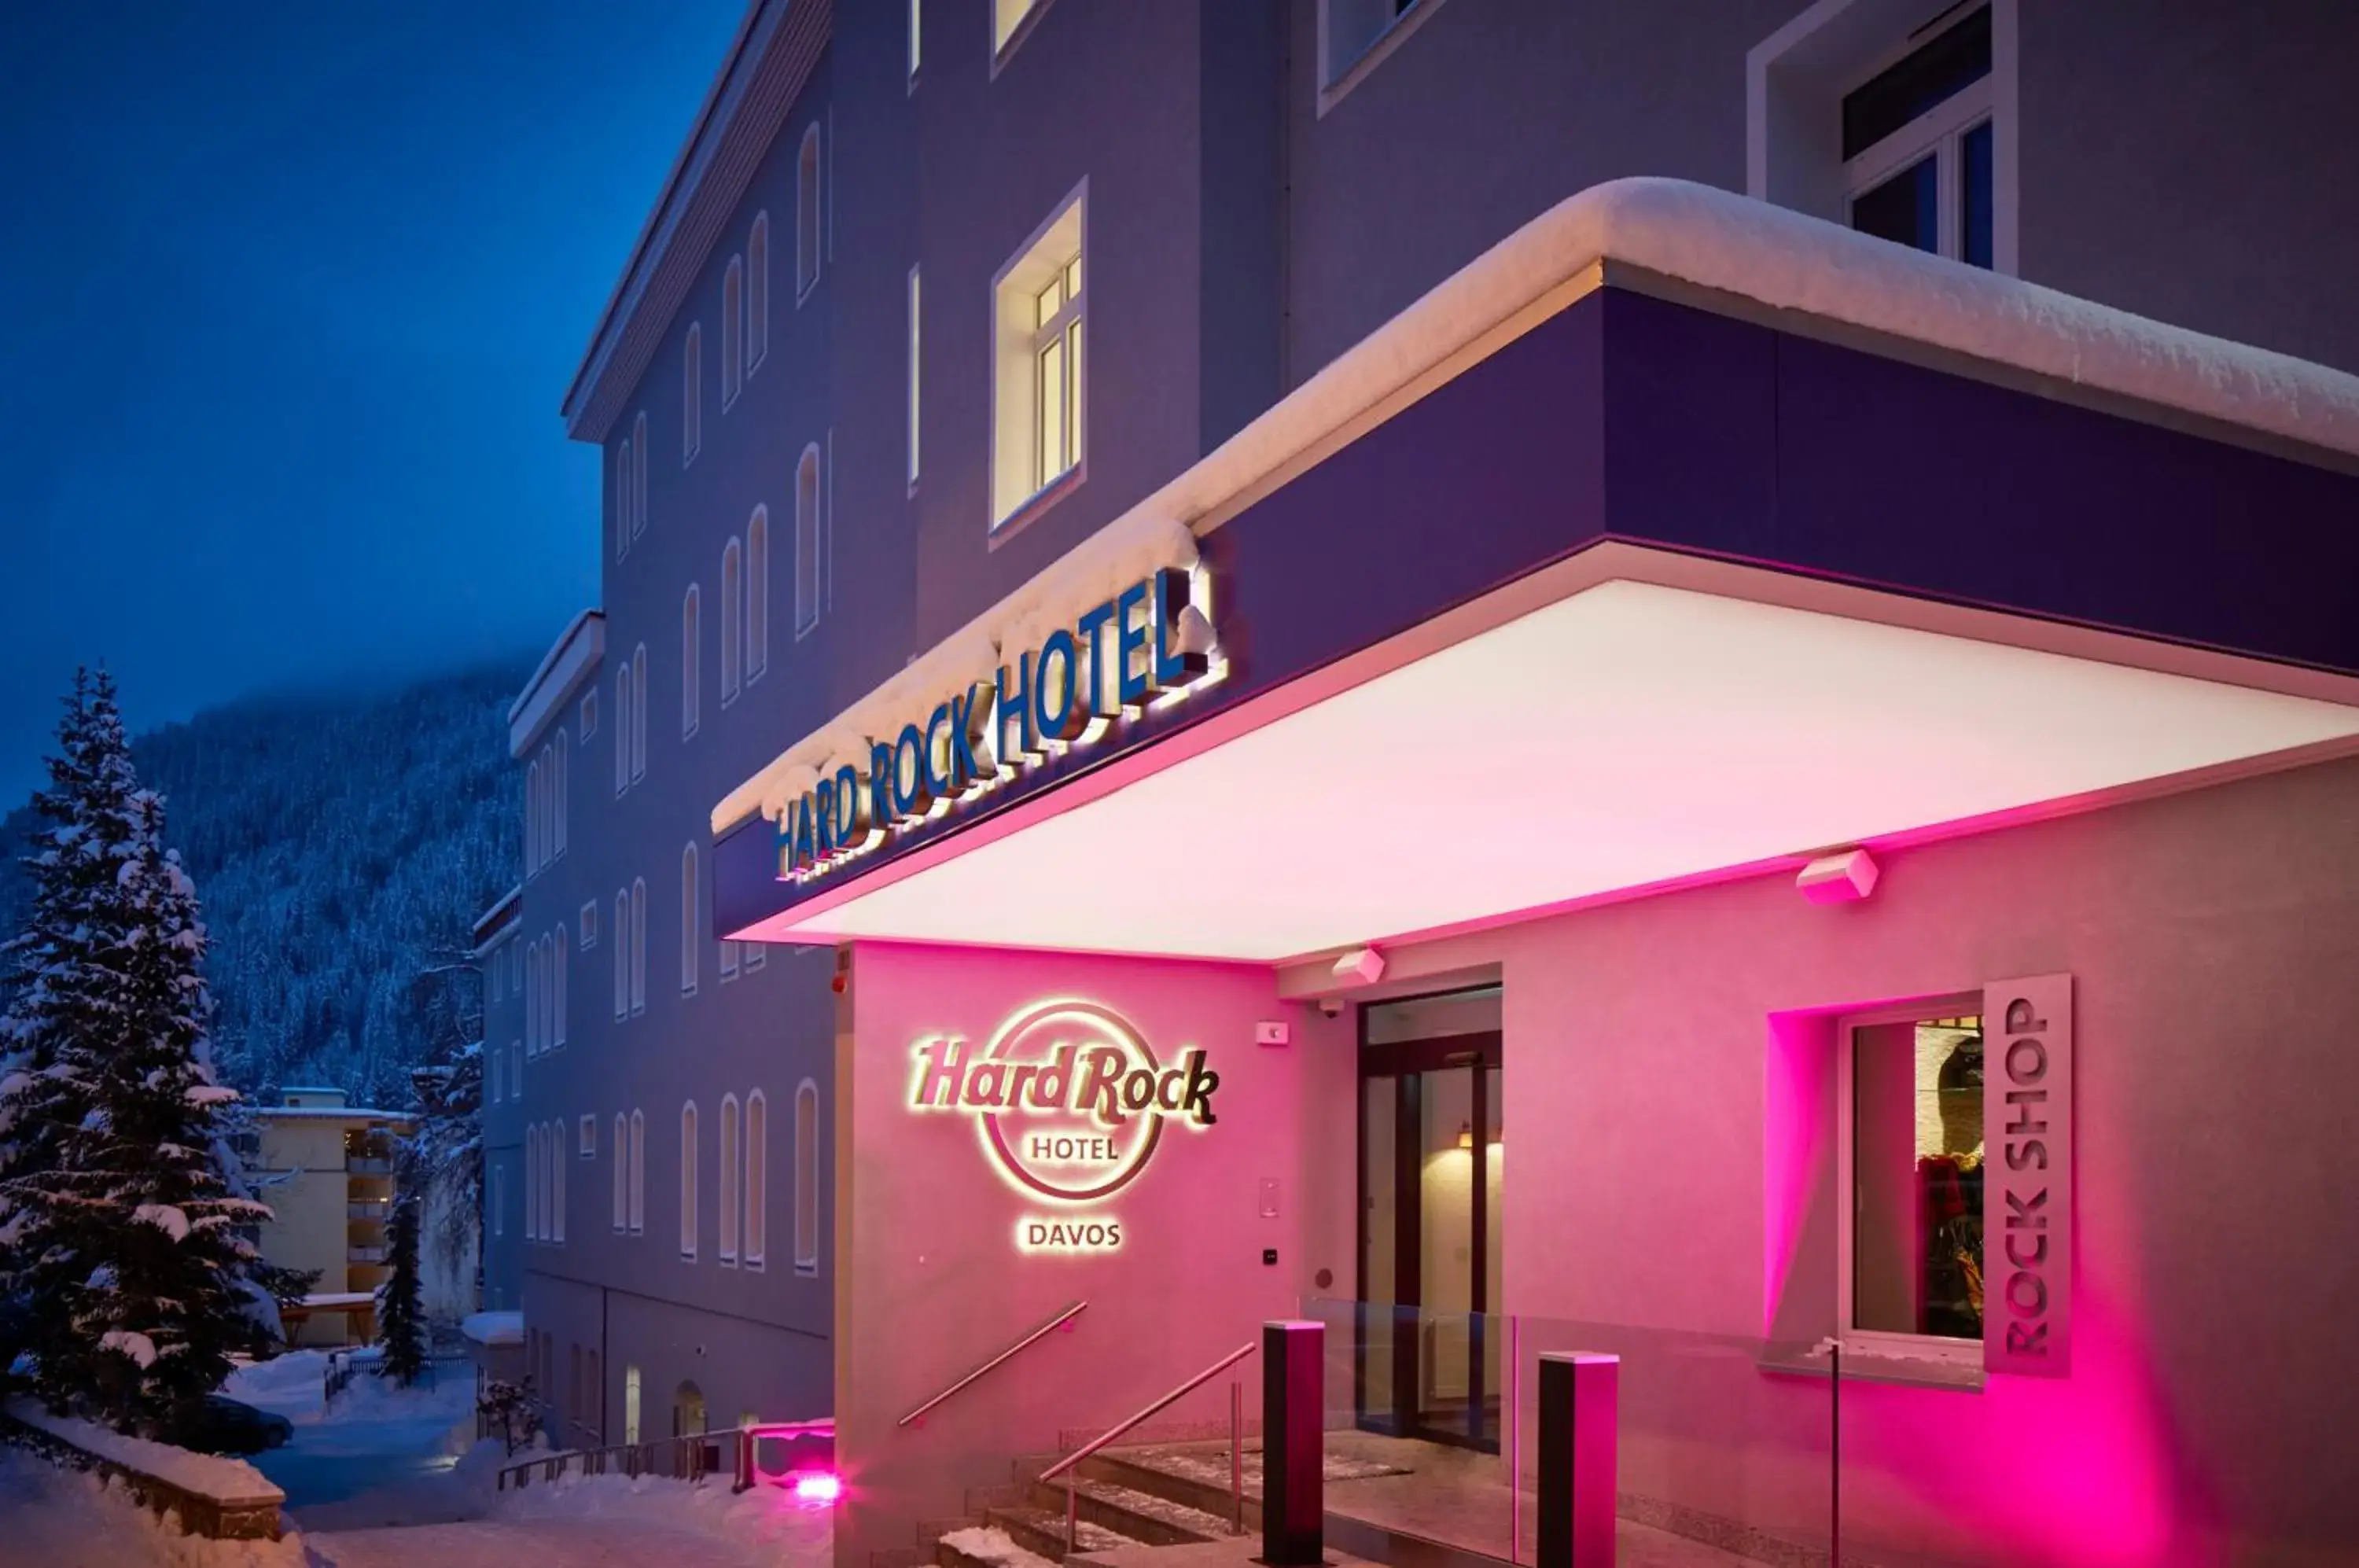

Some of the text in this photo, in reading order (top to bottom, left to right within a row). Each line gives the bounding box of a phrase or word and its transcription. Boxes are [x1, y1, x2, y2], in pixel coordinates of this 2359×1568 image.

[775, 566, 1186, 874] HARD ROCK HOTEL
[915, 1040, 1220, 1125] Hard Rock
[1032, 1137, 1119, 1161] HOTEL
[2005, 997, 2048, 1357] ROCK SHOP
[1029, 1223, 1121, 1246] DAVOS
